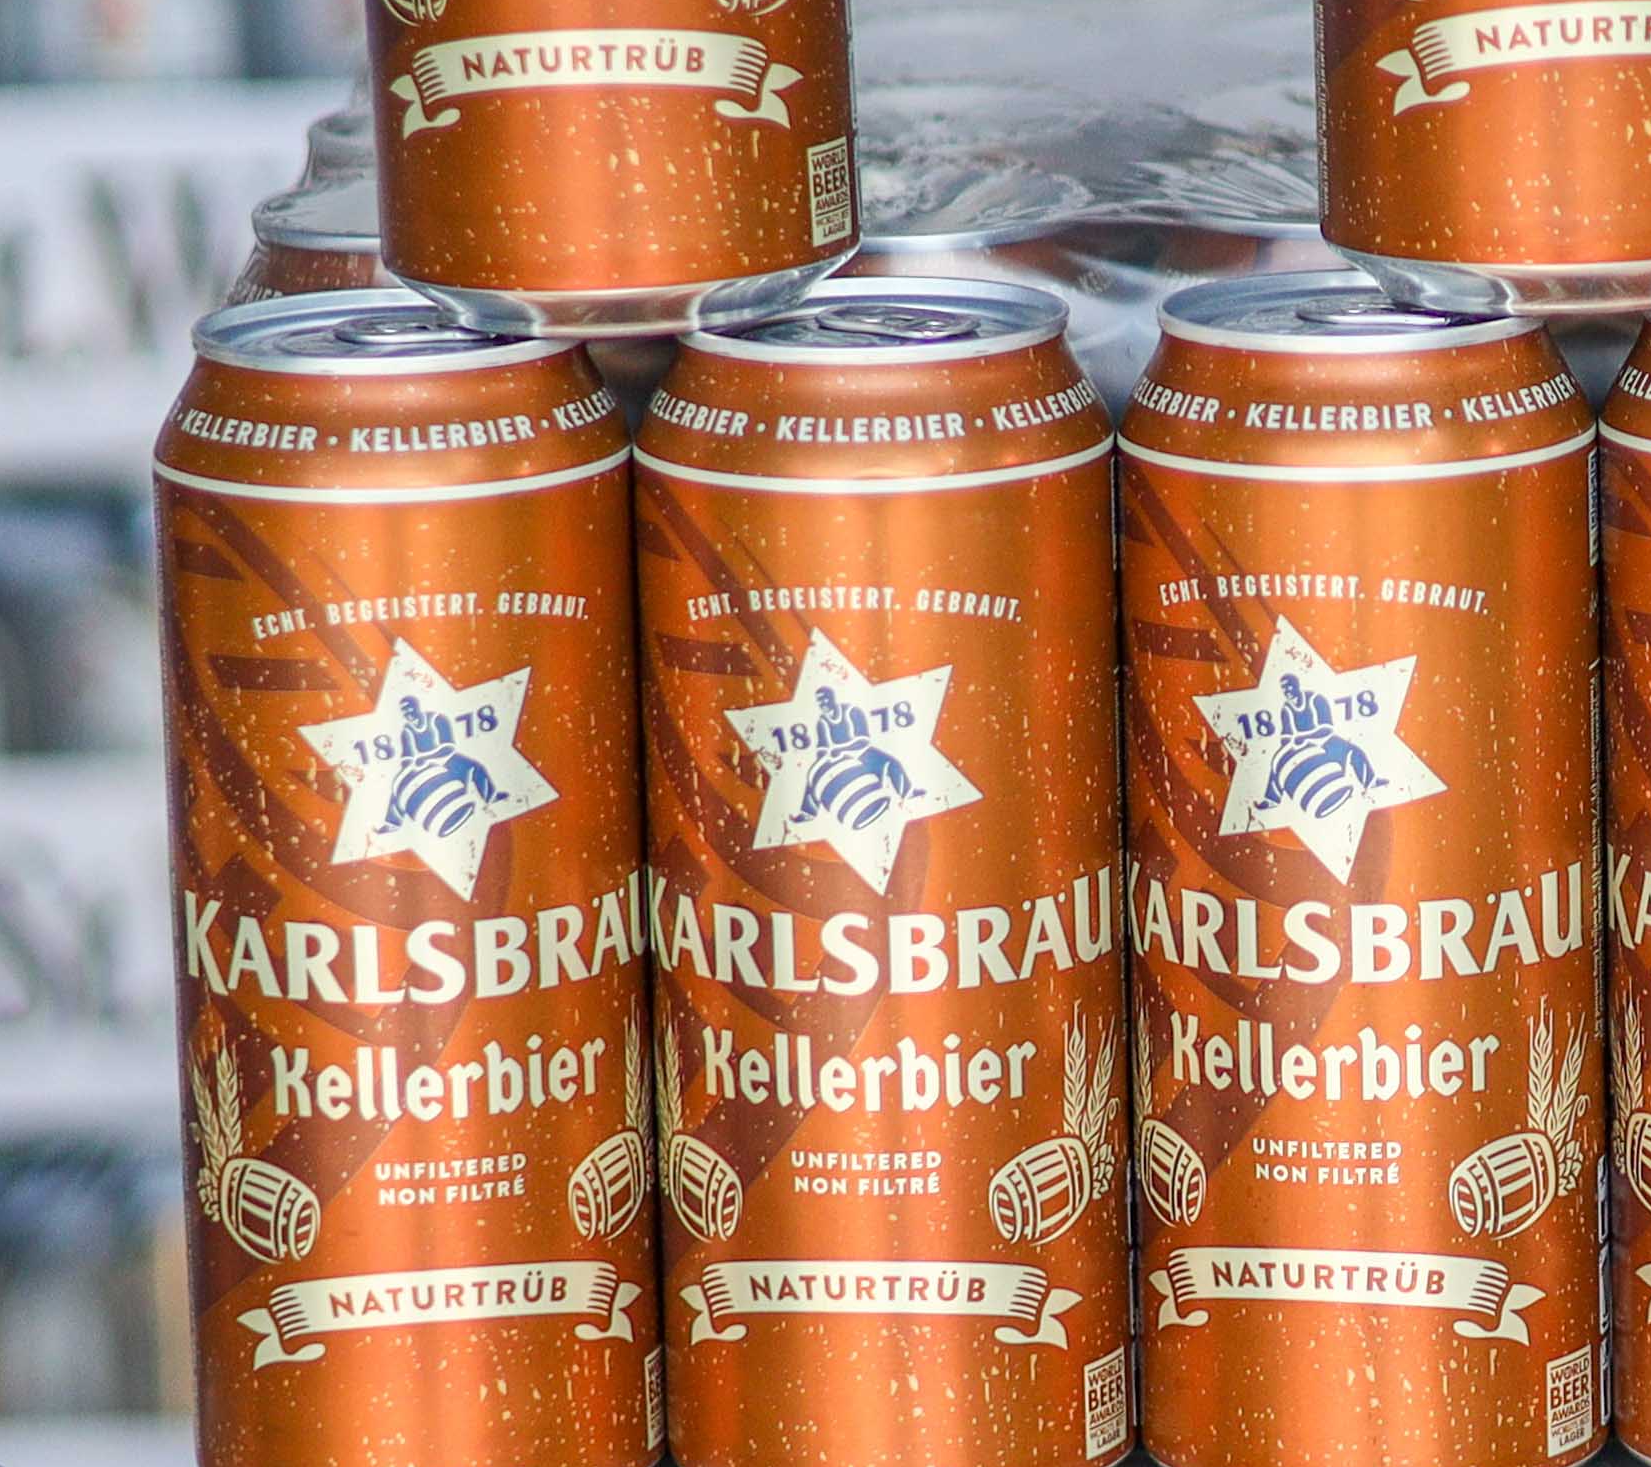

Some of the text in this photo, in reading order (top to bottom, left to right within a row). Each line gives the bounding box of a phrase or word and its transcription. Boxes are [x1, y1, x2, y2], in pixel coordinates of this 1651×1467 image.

[463, 38, 706, 81] NATURTRÜB
[777, 414, 965, 442] KELLERBIER
[1246, 403, 1433, 430] KELLERBIER
[351, 416, 535, 452] KELLERBIER
[687, 589, 1022, 622] ECHT. BEGEISTERT. GEBRAUT.
[1238, 690, 1379, 739] 18 78
[648, 866, 1110, 995] KARLSBRÄU
[703, 1027, 1035, 1113] Kellerbier
[1170, 1009, 1499, 1101] Kellerbier
[270, 1034, 605, 1123] Kellerbier
[1253, 1137, 1402, 1159] UNFILTERED
[375, 1153, 526, 1181] UNFILTERED
[1255, 1162, 1400, 1184] NON FILTRÉ
[379, 1176, 525, 1206] NON FILTRÉ
[750, 1270, 986, 1303] NATURTRÜB
[1212, 1260, 1445, 1294] NATURTRÜB
[329, 1271, 567, 1318] NATURTRÜB
[1550, 1377, 1590, 1410] BEER
